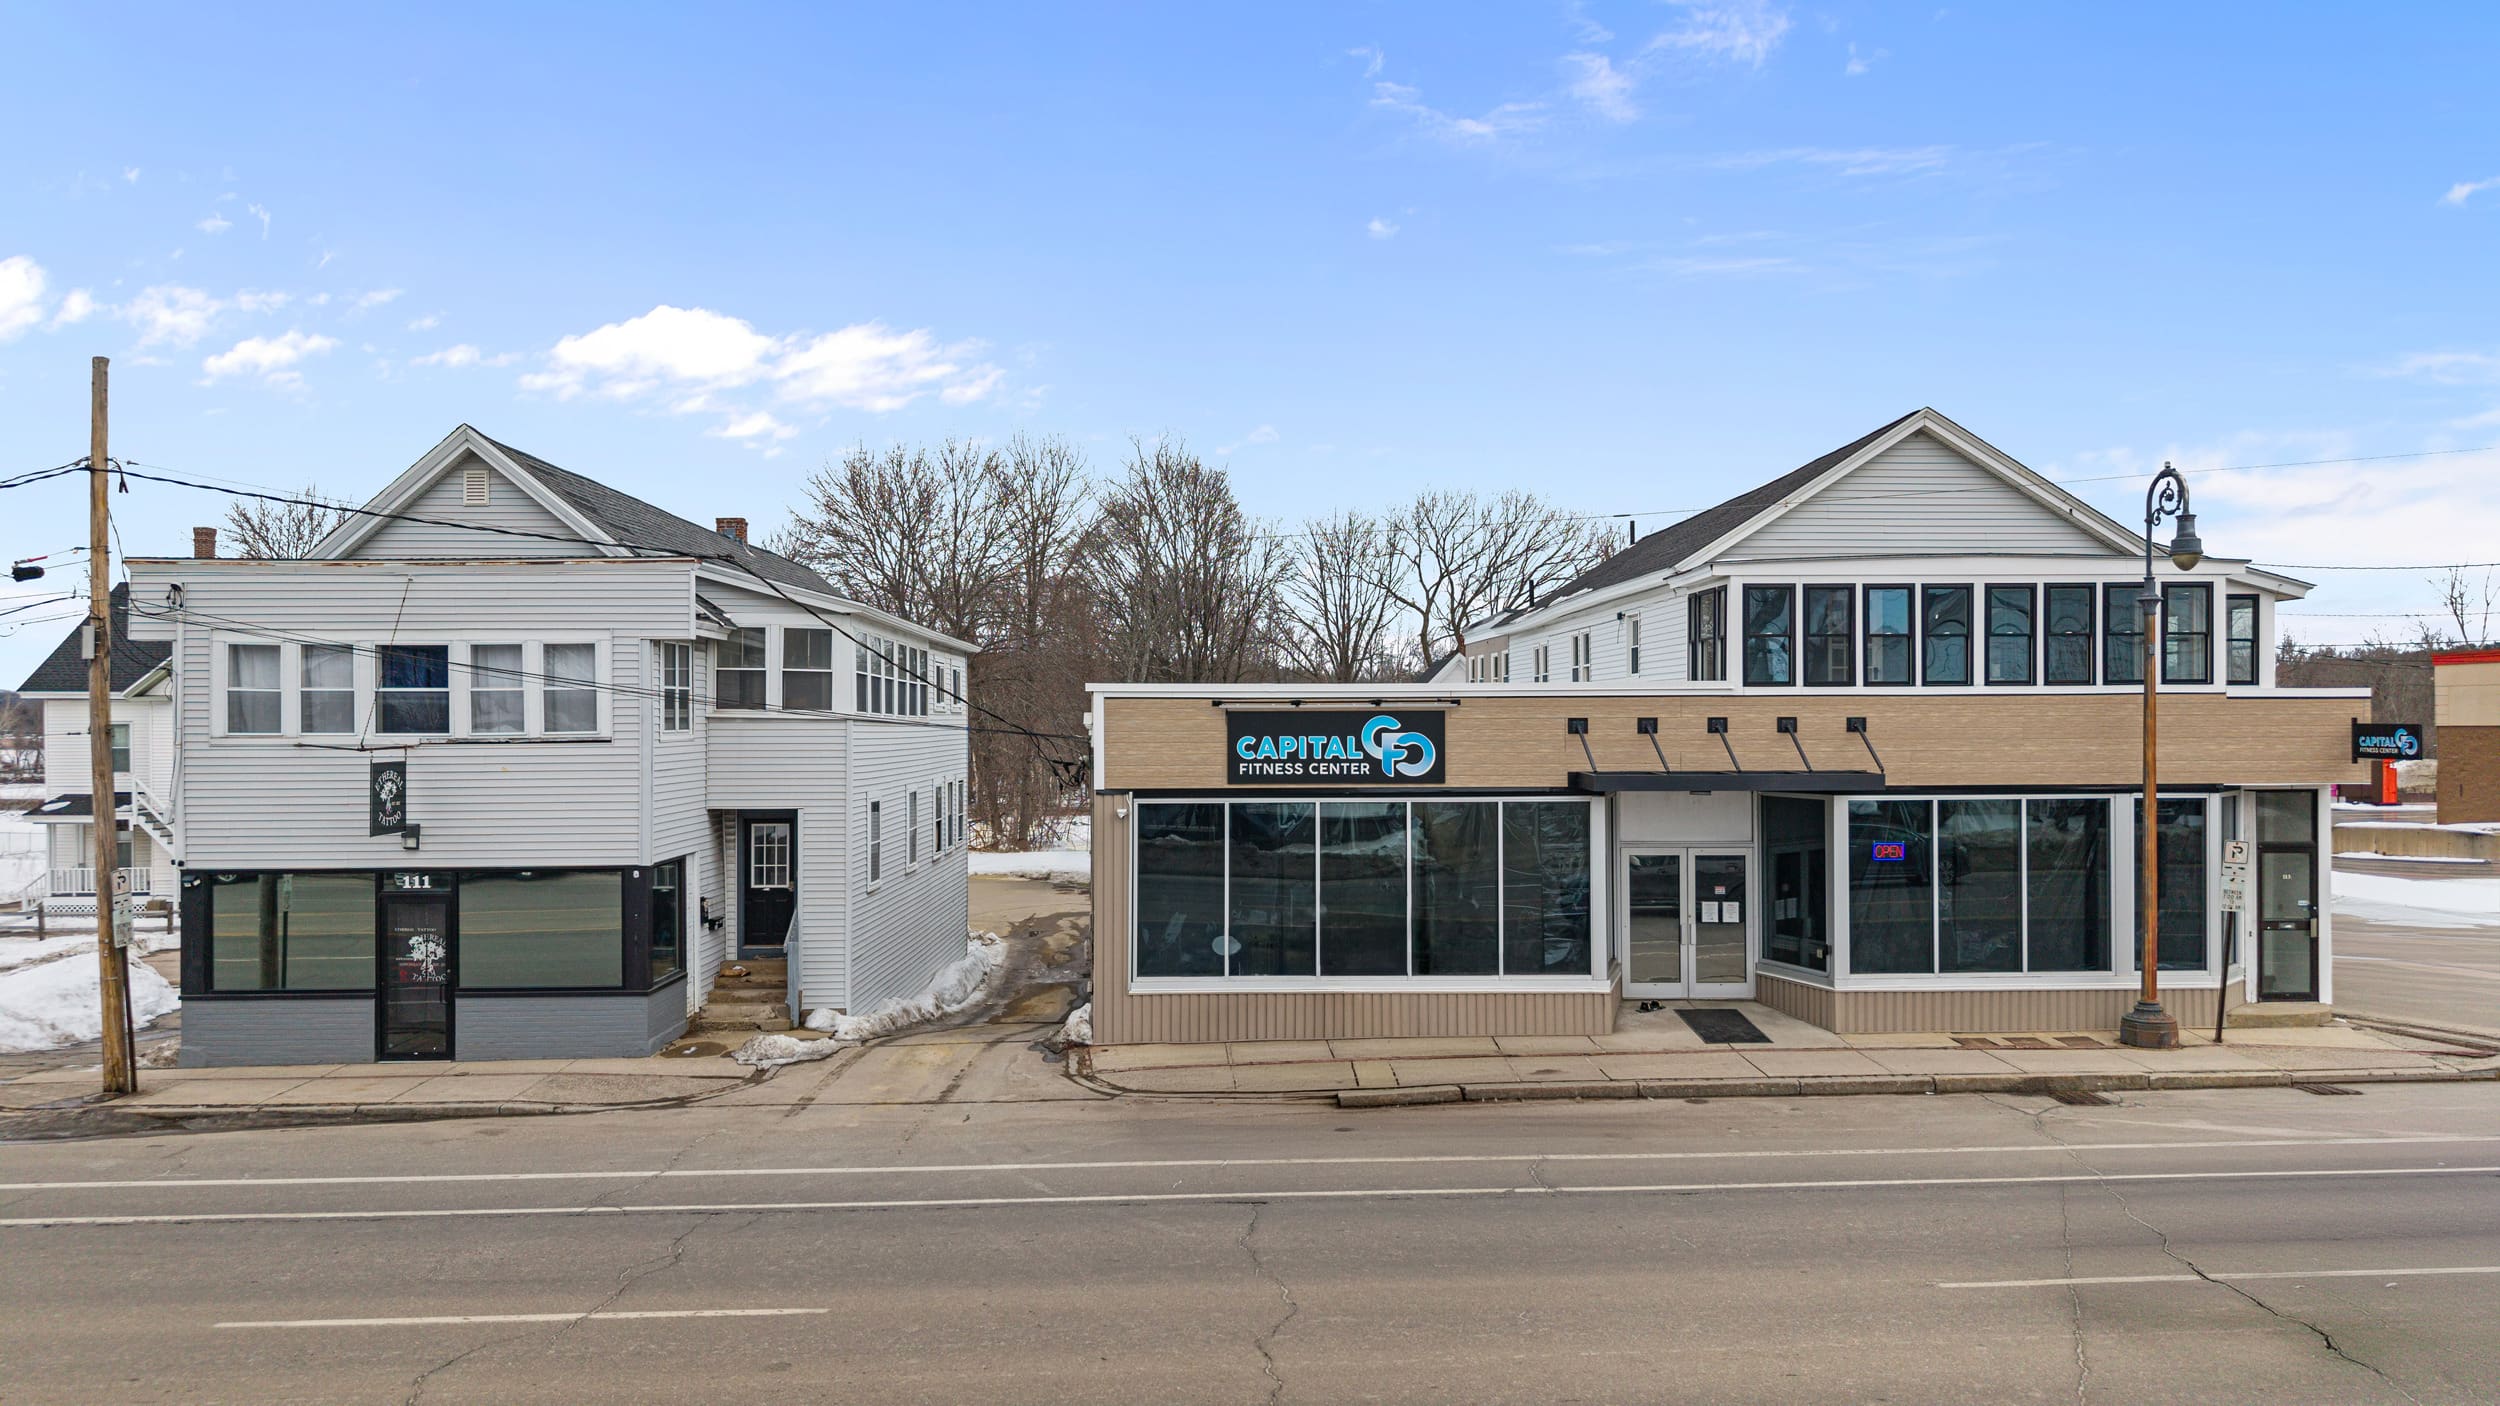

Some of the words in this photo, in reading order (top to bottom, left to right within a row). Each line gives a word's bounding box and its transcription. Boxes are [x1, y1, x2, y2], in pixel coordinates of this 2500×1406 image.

[1236, 735, 1364, 760] CAPITAL
[2359, 736, 2396, 747] CAPITAL
[1239, 762, 1304, 775] FITNESS
[1308, 762, 1370, 775] CENTER
[378, 810, 402, 826] TATTOO
[1876, 844, 1903, 858] OPEN
[402, 875, 432, 889] 111
